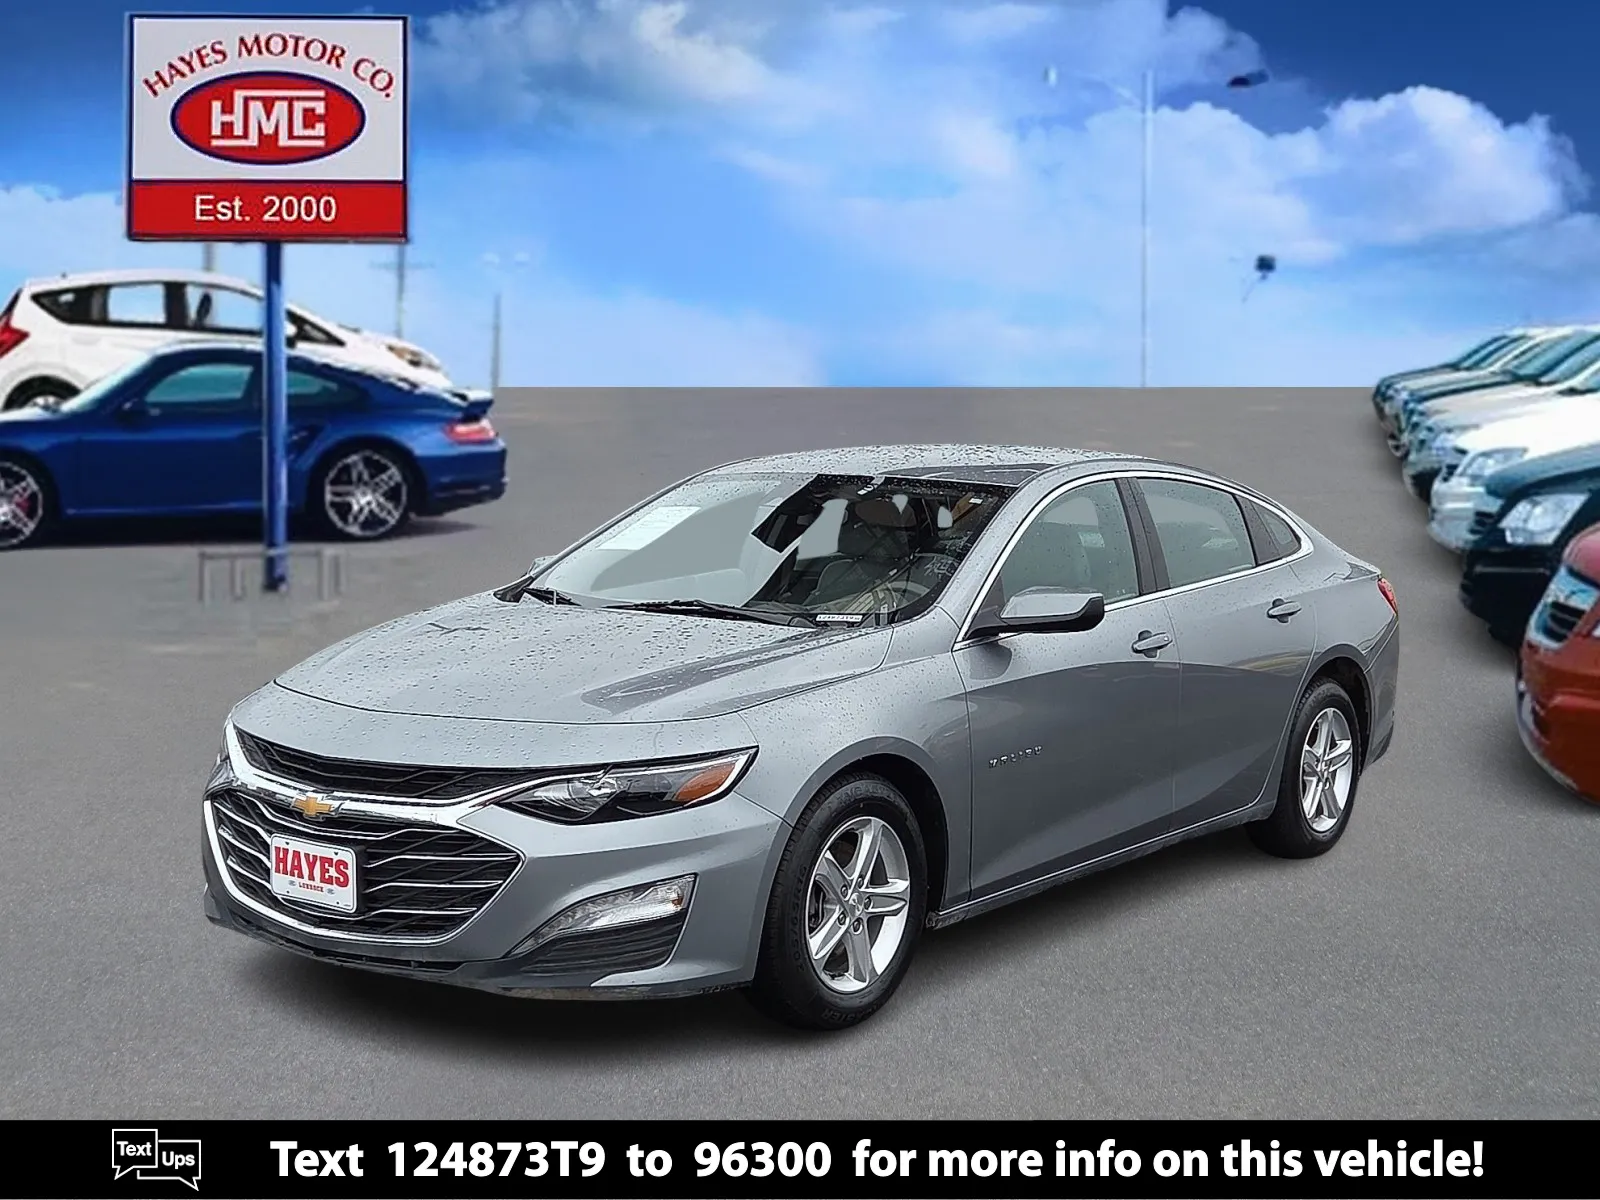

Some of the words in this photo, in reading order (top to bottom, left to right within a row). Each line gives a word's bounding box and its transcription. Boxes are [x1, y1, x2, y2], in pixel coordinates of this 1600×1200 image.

[142, 40, 228, 98] HAYES
[237, 33, 347, 70] MOTOR
[352, 57, 394, 99] CO.
[210, 89, 326, 147] HMC
[195, 195, 250, 221] Est.
[263, 195, 337, 222] 2000
[274, 846, 350, 888] HAYES
